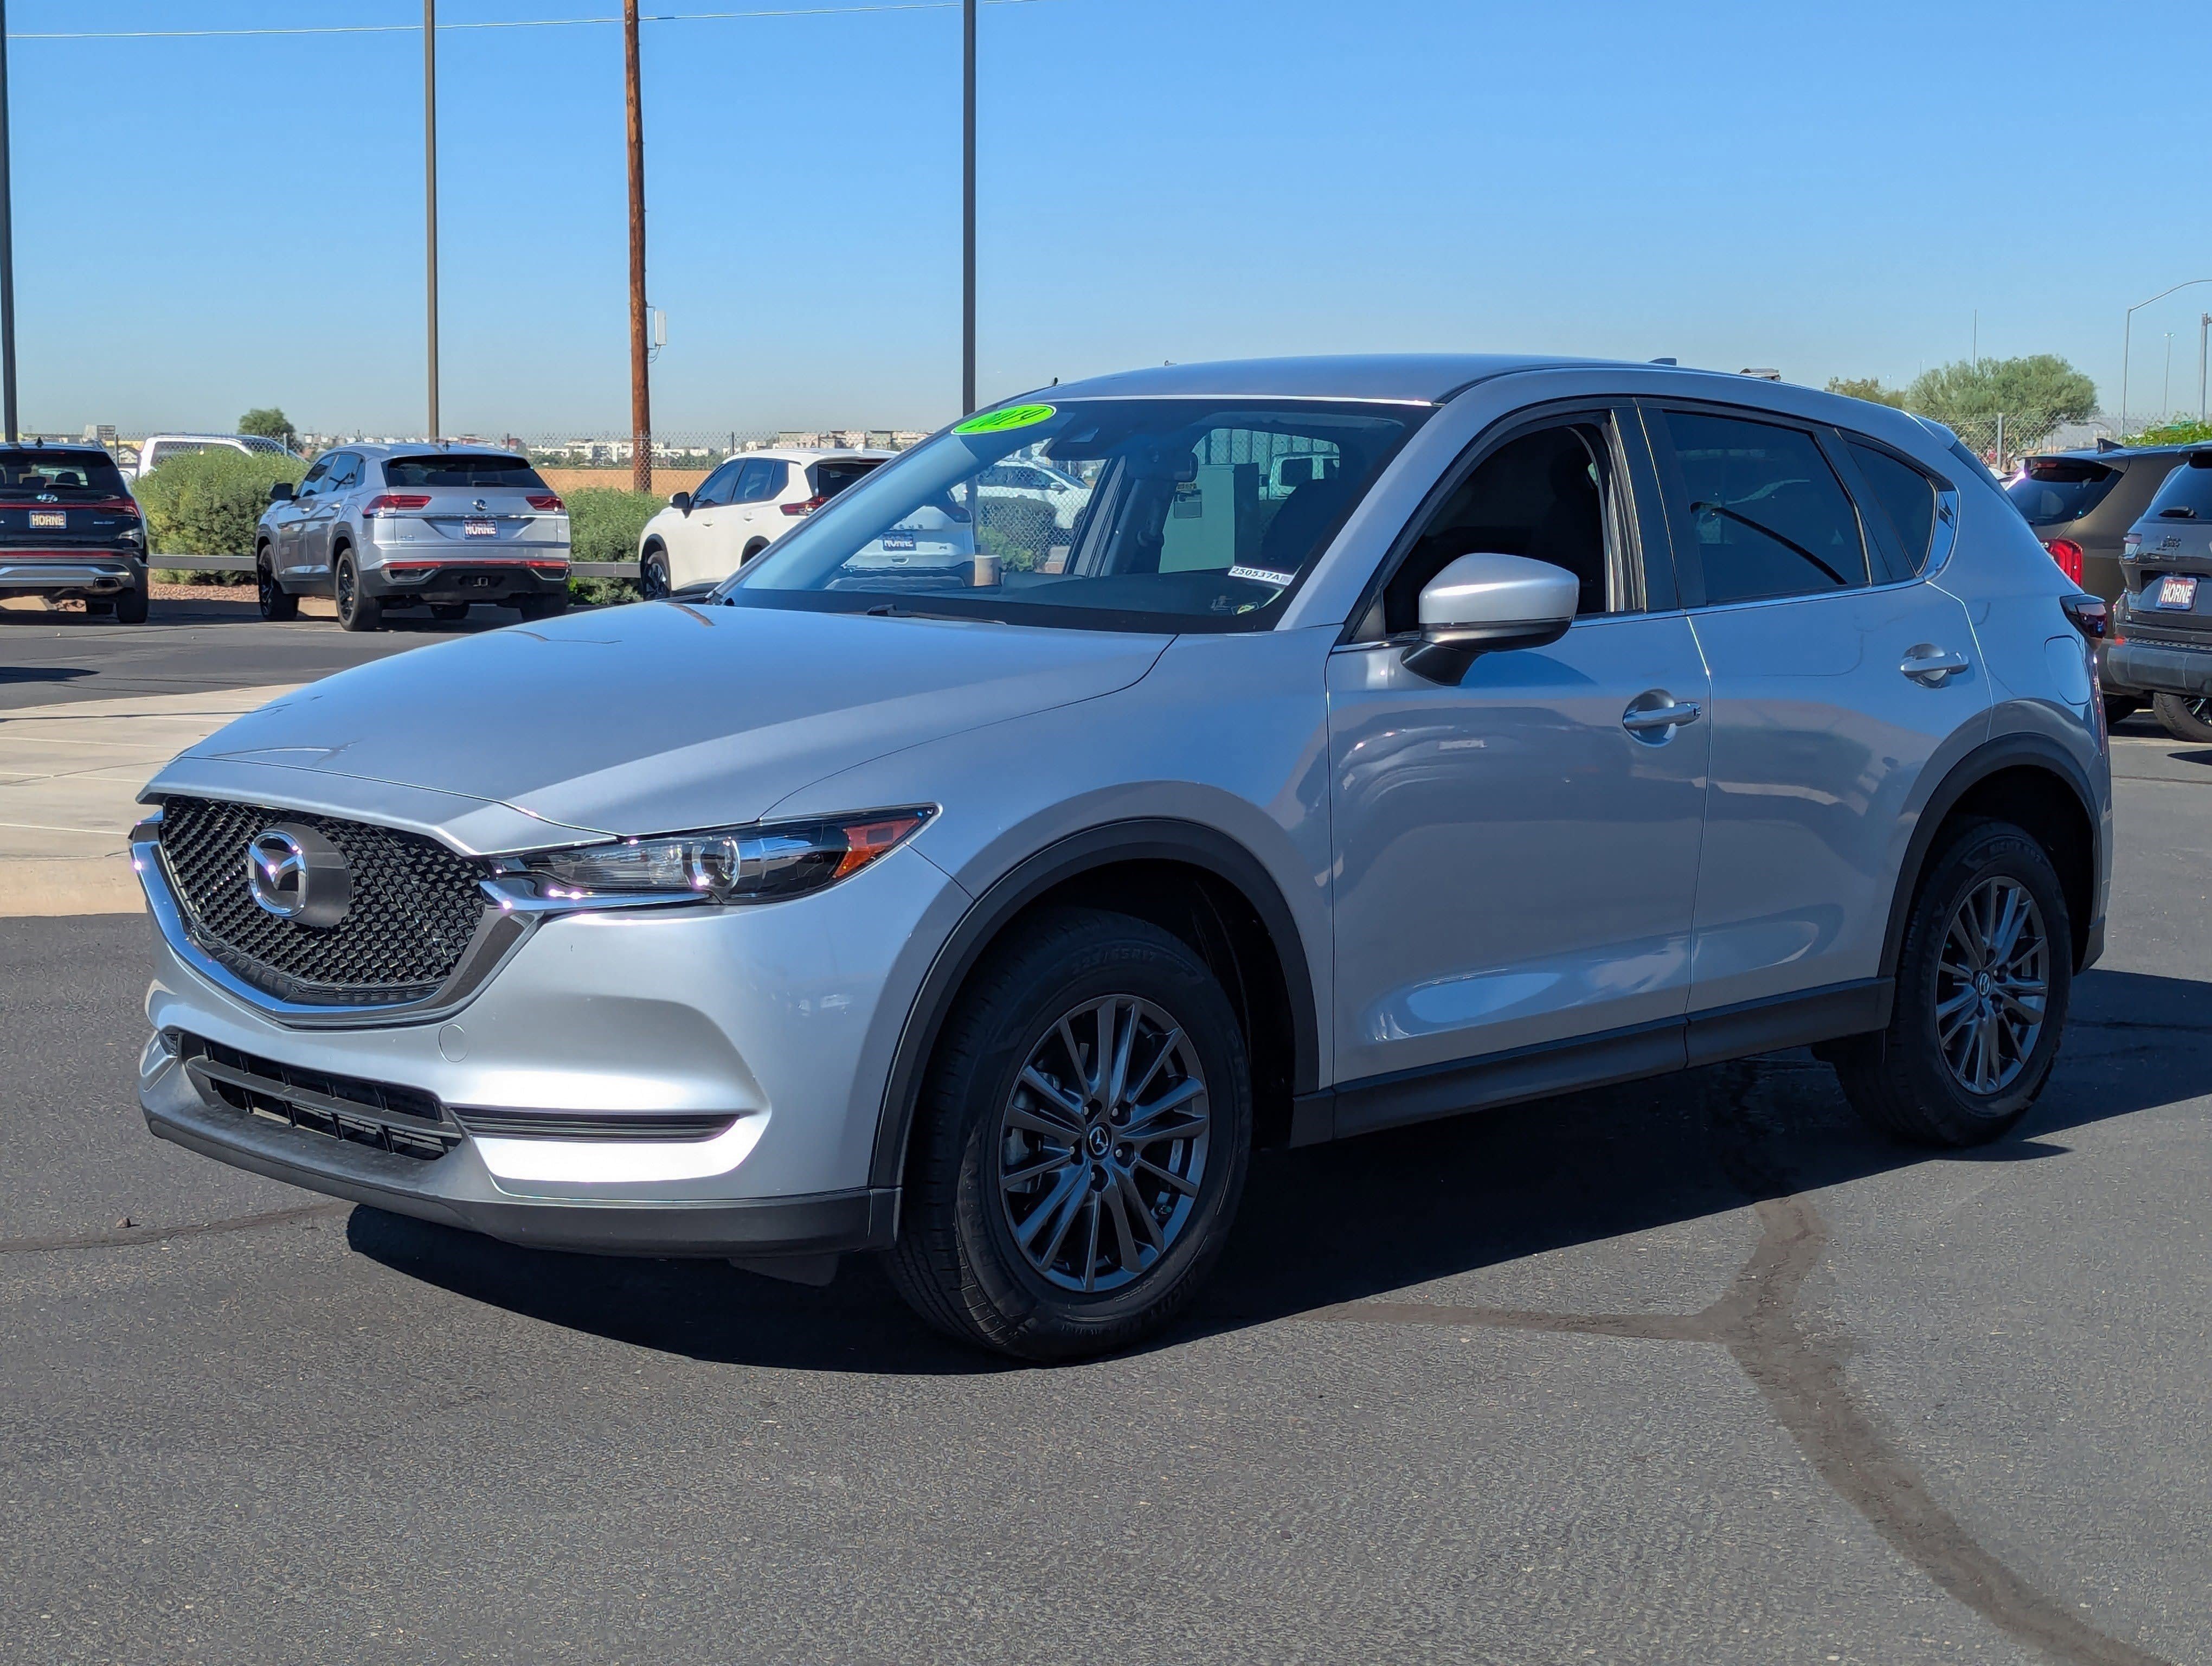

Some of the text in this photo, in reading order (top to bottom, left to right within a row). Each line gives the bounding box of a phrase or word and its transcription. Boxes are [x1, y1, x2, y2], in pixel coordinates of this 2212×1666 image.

[32, 515, 65, 526] HORNE
[465, 522, 496, 535] HORNE
[2160, 582, 2194, 604] HORNE
